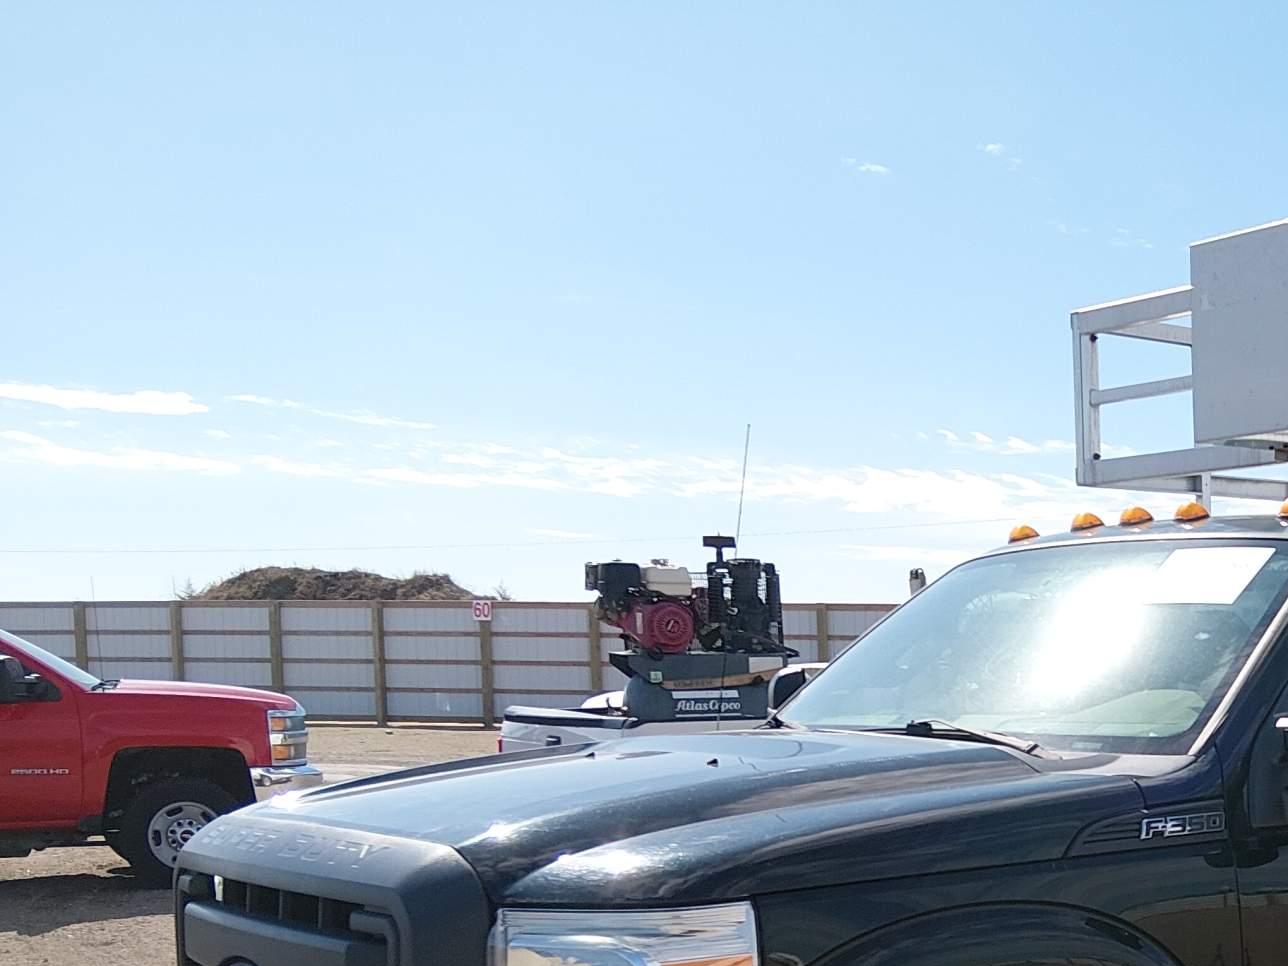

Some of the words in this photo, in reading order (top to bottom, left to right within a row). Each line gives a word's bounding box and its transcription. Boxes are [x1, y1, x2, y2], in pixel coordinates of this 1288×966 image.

[473, 601, 490, 618] 60
[674, 700, 709, 712] Atlas
[1139, 811, 1225, 840] F-350
[277, 833, 391, 870] DUTY
